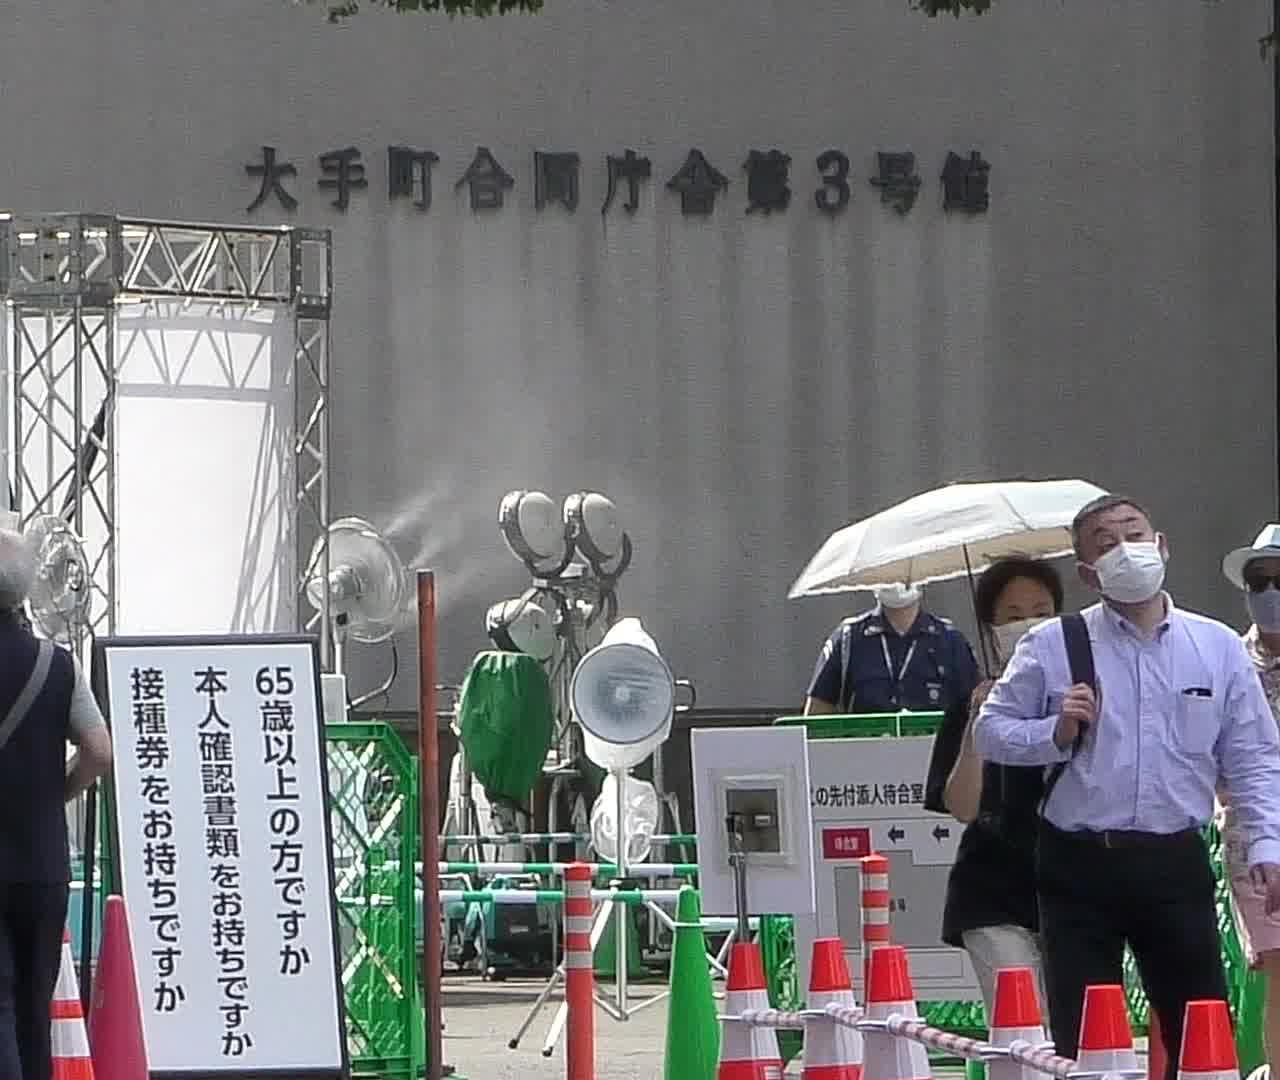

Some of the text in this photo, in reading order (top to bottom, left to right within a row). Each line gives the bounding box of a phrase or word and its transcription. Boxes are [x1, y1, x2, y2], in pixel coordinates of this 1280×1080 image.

[130, 667, 186, 1012] 接種券をお持ちですか
[194, 666, 253, 1056] 本人確認書類をお持ちですか
[255, 666, 310, 975] 65歳以上の方ですか
